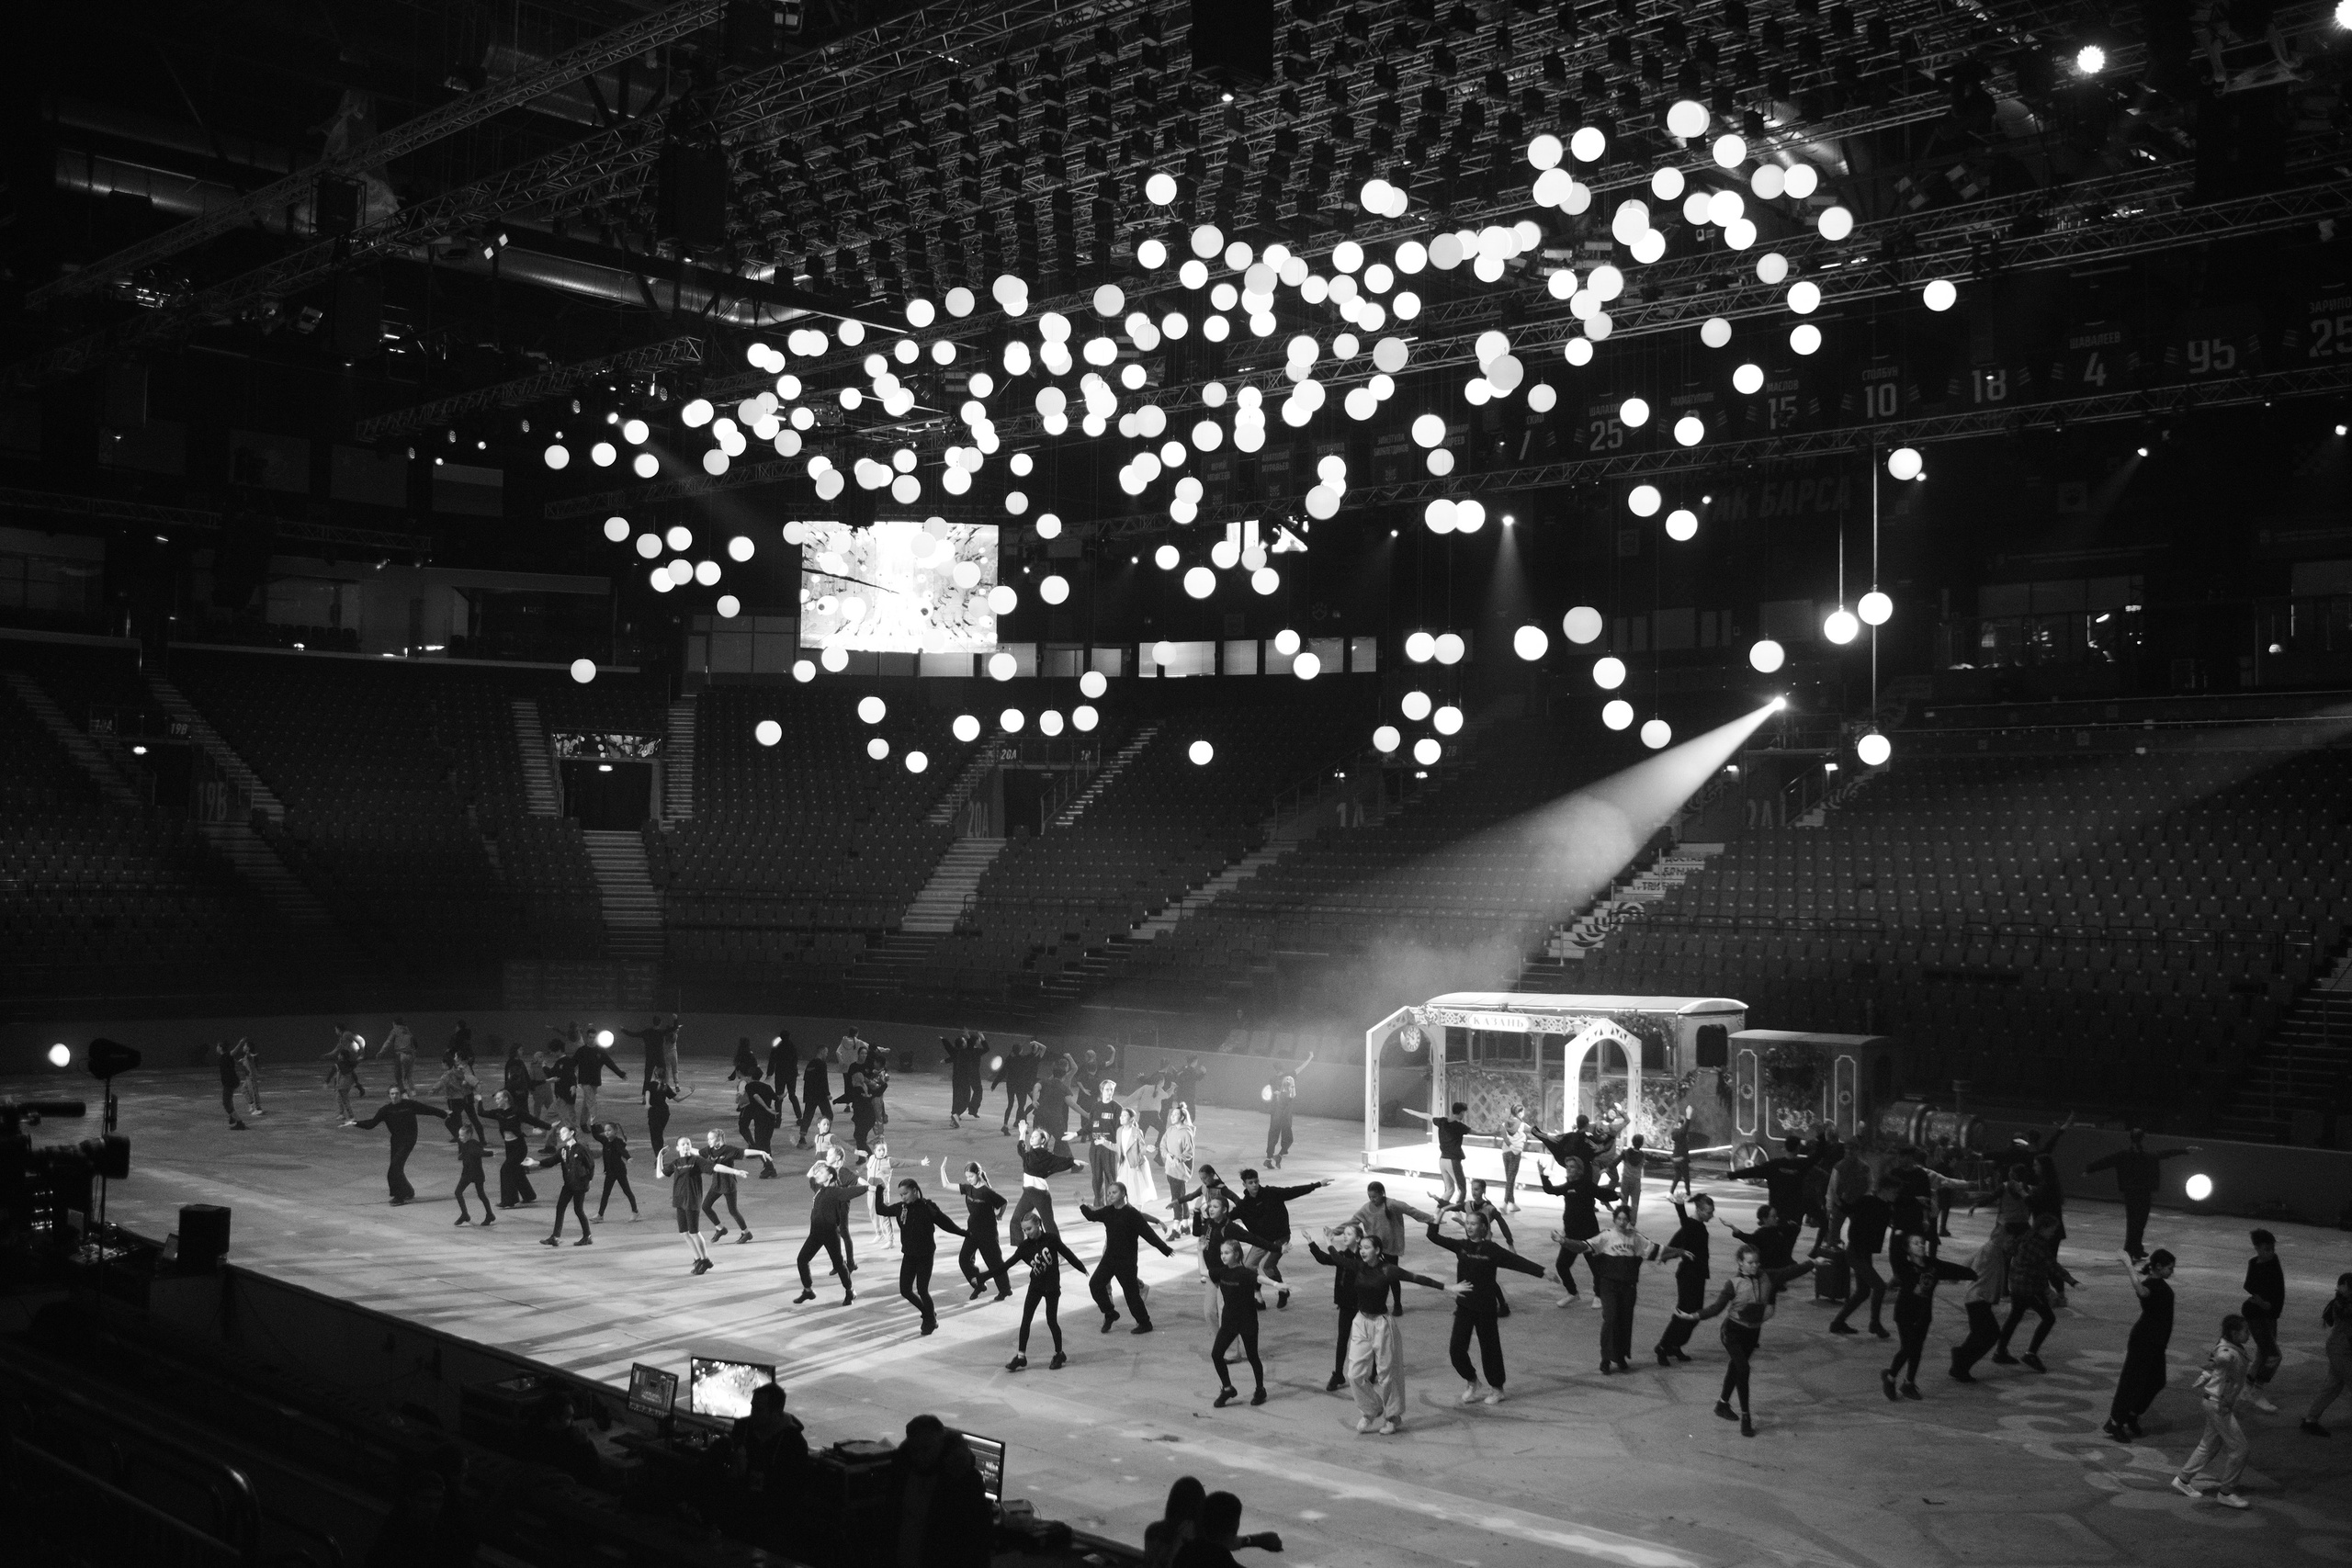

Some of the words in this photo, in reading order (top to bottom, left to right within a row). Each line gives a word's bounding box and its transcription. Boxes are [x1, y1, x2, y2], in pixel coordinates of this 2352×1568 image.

[2069, 331, 2121, 350] ШАВАЛЕЕВ
[2309, 315, 2352, 357] 25
[1861, 366, 1899, 381] СТОЛБУН
[2083, 352, 2108, 388] 4
[2188, 338, 2236, 375] 95
[1766, 378, 1800, 393] МАСЛОВ
[1864, 382, 1898, 419] 10
[1971, 368, 2007, 404] 18
[1768, 395, 1799, 431] 15
[1589, 418, 1624, 452] 25
[1758, 475, 1851, 518] БАРСА
[1474, 1016, 1524, 1028] КАЗАНЬ
